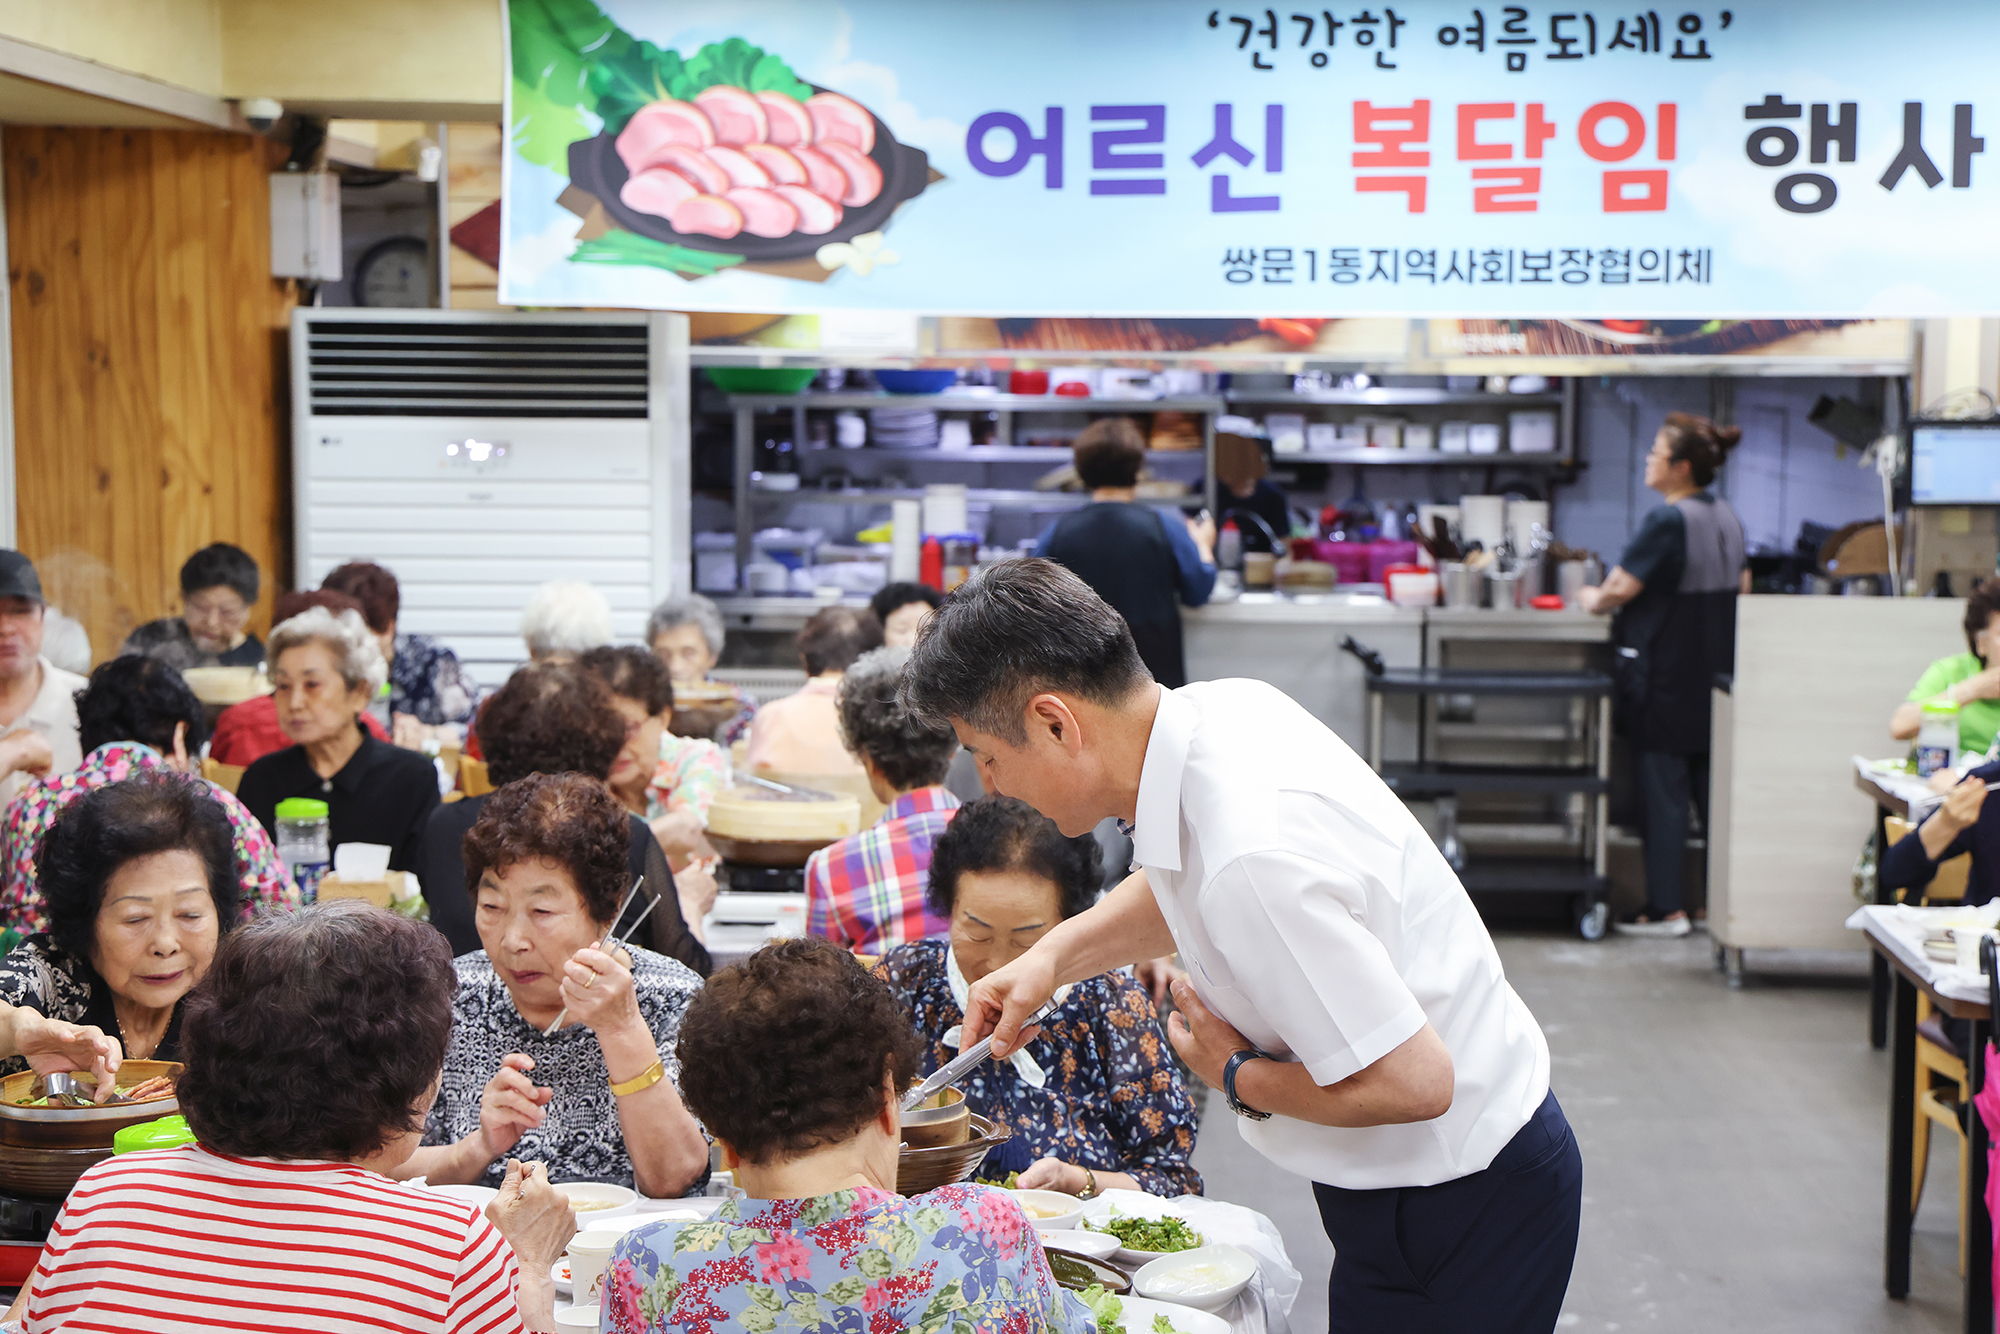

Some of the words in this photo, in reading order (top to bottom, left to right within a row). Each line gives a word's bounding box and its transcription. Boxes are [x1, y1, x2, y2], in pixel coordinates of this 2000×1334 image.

[1207, 9, 1406, 70] ‘건강한
[965, 103, 1283, 213] 어르신
[1351, 99, 1678, 213] 복달임
[1743, 94, 1985, 214] 행사
[1222, 247, 1712, 285] 쌍문1동지역사회보장협의체
